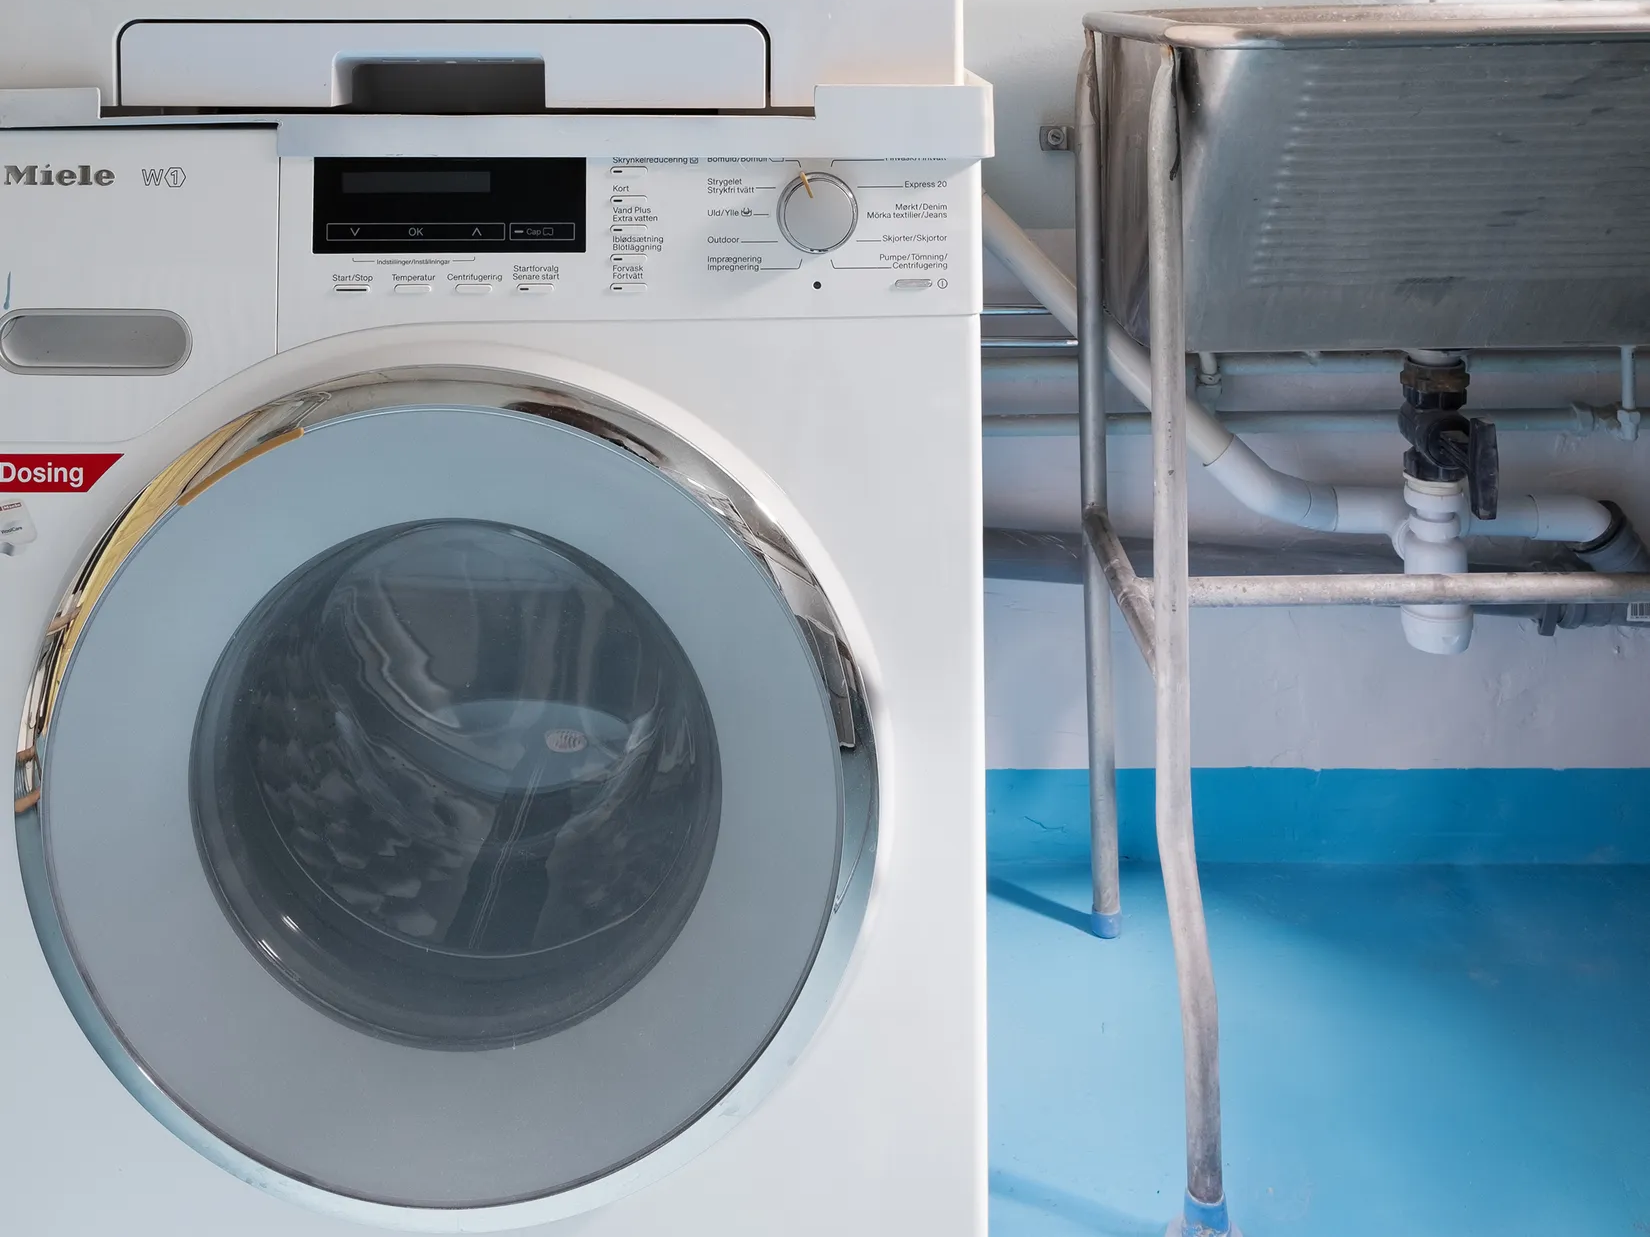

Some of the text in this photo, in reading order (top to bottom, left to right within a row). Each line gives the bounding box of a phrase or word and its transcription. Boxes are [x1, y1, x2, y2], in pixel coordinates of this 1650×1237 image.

[4, 164, 116, 186] Miele
[707, 178, 742, 186] Strygelet
[904, 180, 936, 188] Express
[707, 186, 736, 194] Strykfri
[893, 211, 948, 219] textilier/Jeans
[408, 228, 424, 236] OK
[526, 228, 541, 238] Cap
[882, 234, 948, 242] Skjorter/Skjortor
[612, 244, 662, 252] Blötläggning
[708, 256, 762, 264] Imprægnering
[514, 265, 559, 274] Startforvalg
[892, 262, 948, 270] Centrifugering
[332, 274, 373, 282] Start/Stop
[447, 274, 502, 282] Centrifugering
[0, 462, 84, 488] Dosing
